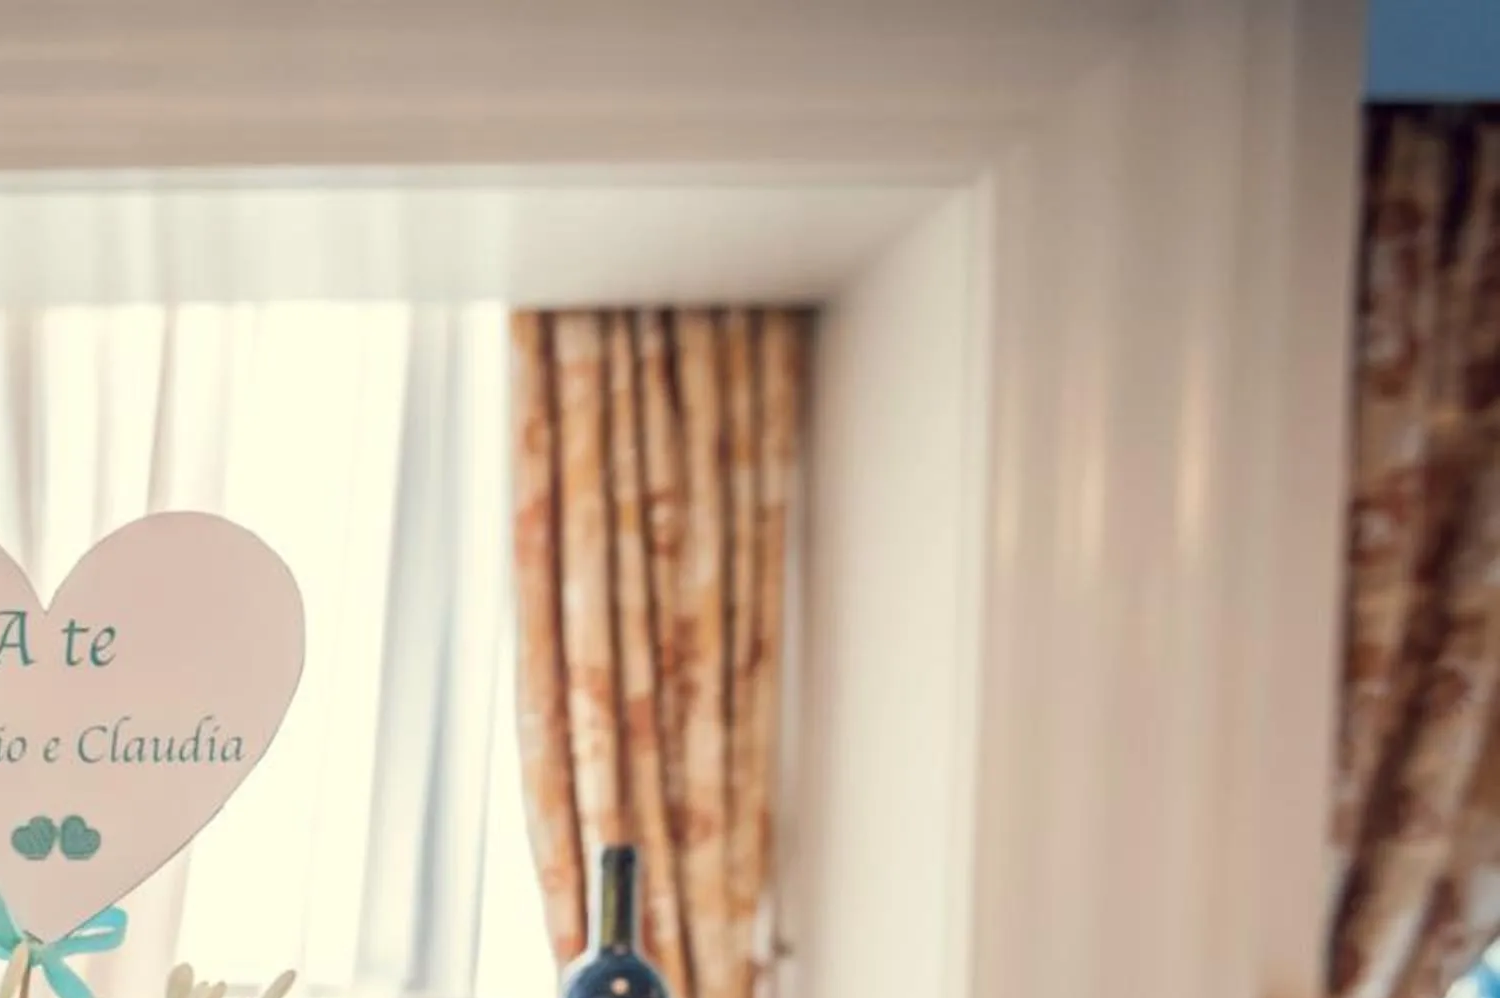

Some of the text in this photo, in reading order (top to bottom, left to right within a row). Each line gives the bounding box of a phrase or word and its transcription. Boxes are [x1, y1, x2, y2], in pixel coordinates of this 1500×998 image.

[60, 618, 117, 667] te
[42, 736, 62, 764] e
[77, 715, 244, 764] Claudia
